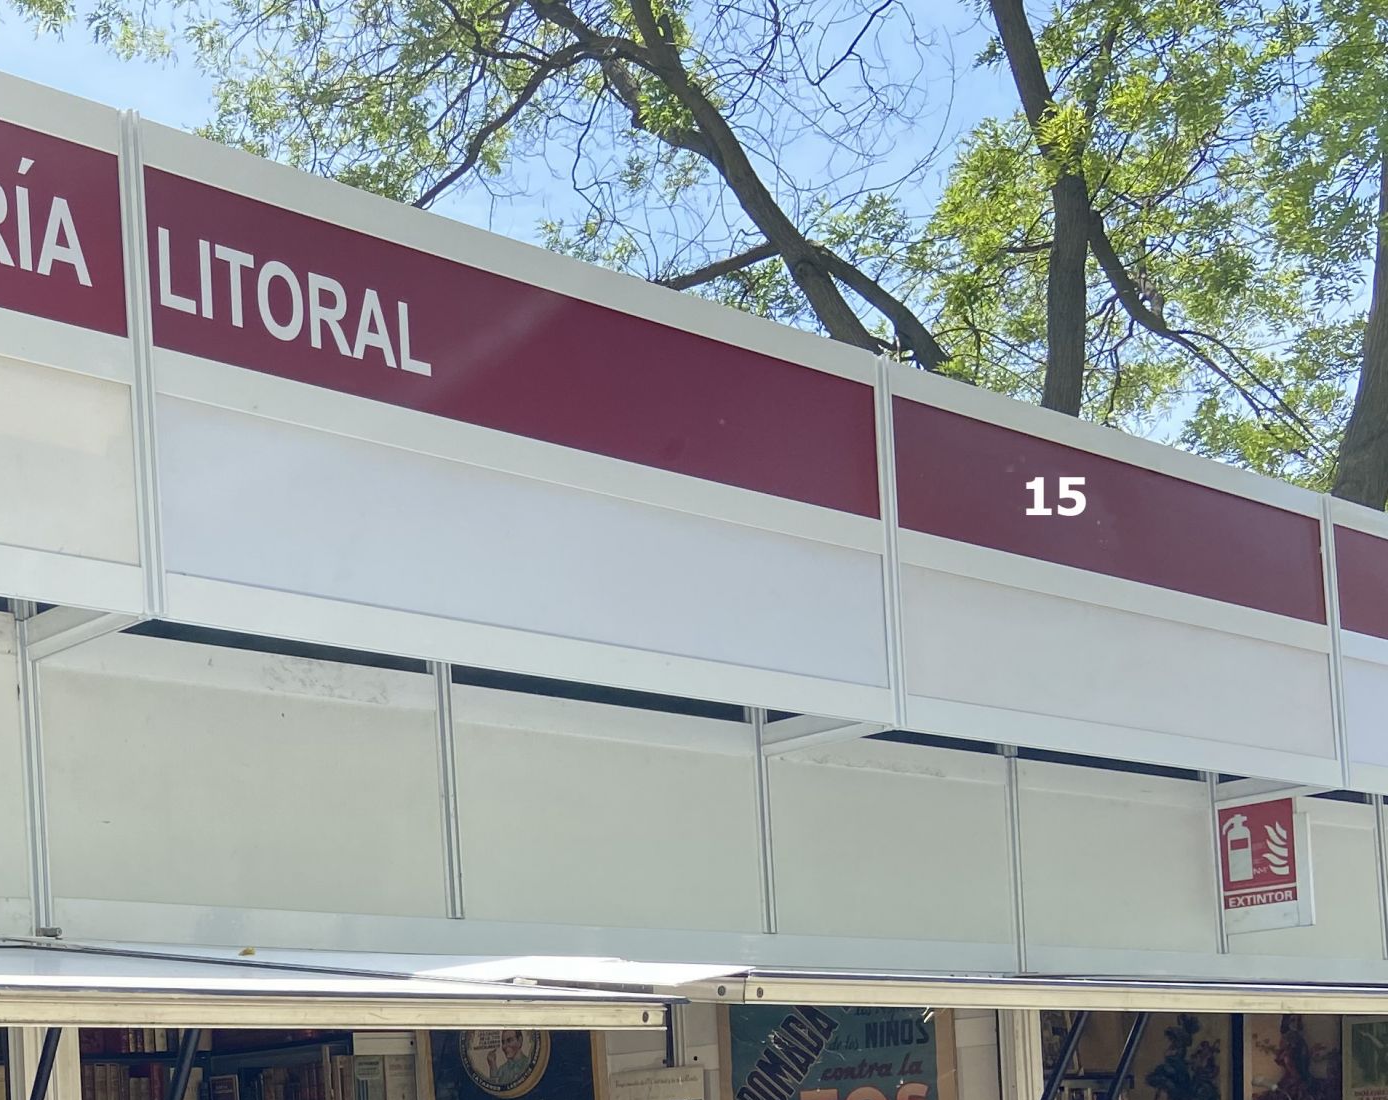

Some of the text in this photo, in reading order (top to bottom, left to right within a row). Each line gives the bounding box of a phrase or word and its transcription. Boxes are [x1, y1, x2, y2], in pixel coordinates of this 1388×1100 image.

[156, 226, 434, 377] LITORAL
[1025, 476, 1087, 517] 15
[1228, 890, 1294, 908] EXTINTOR
[819, 1052, 924, 1081] contra la
